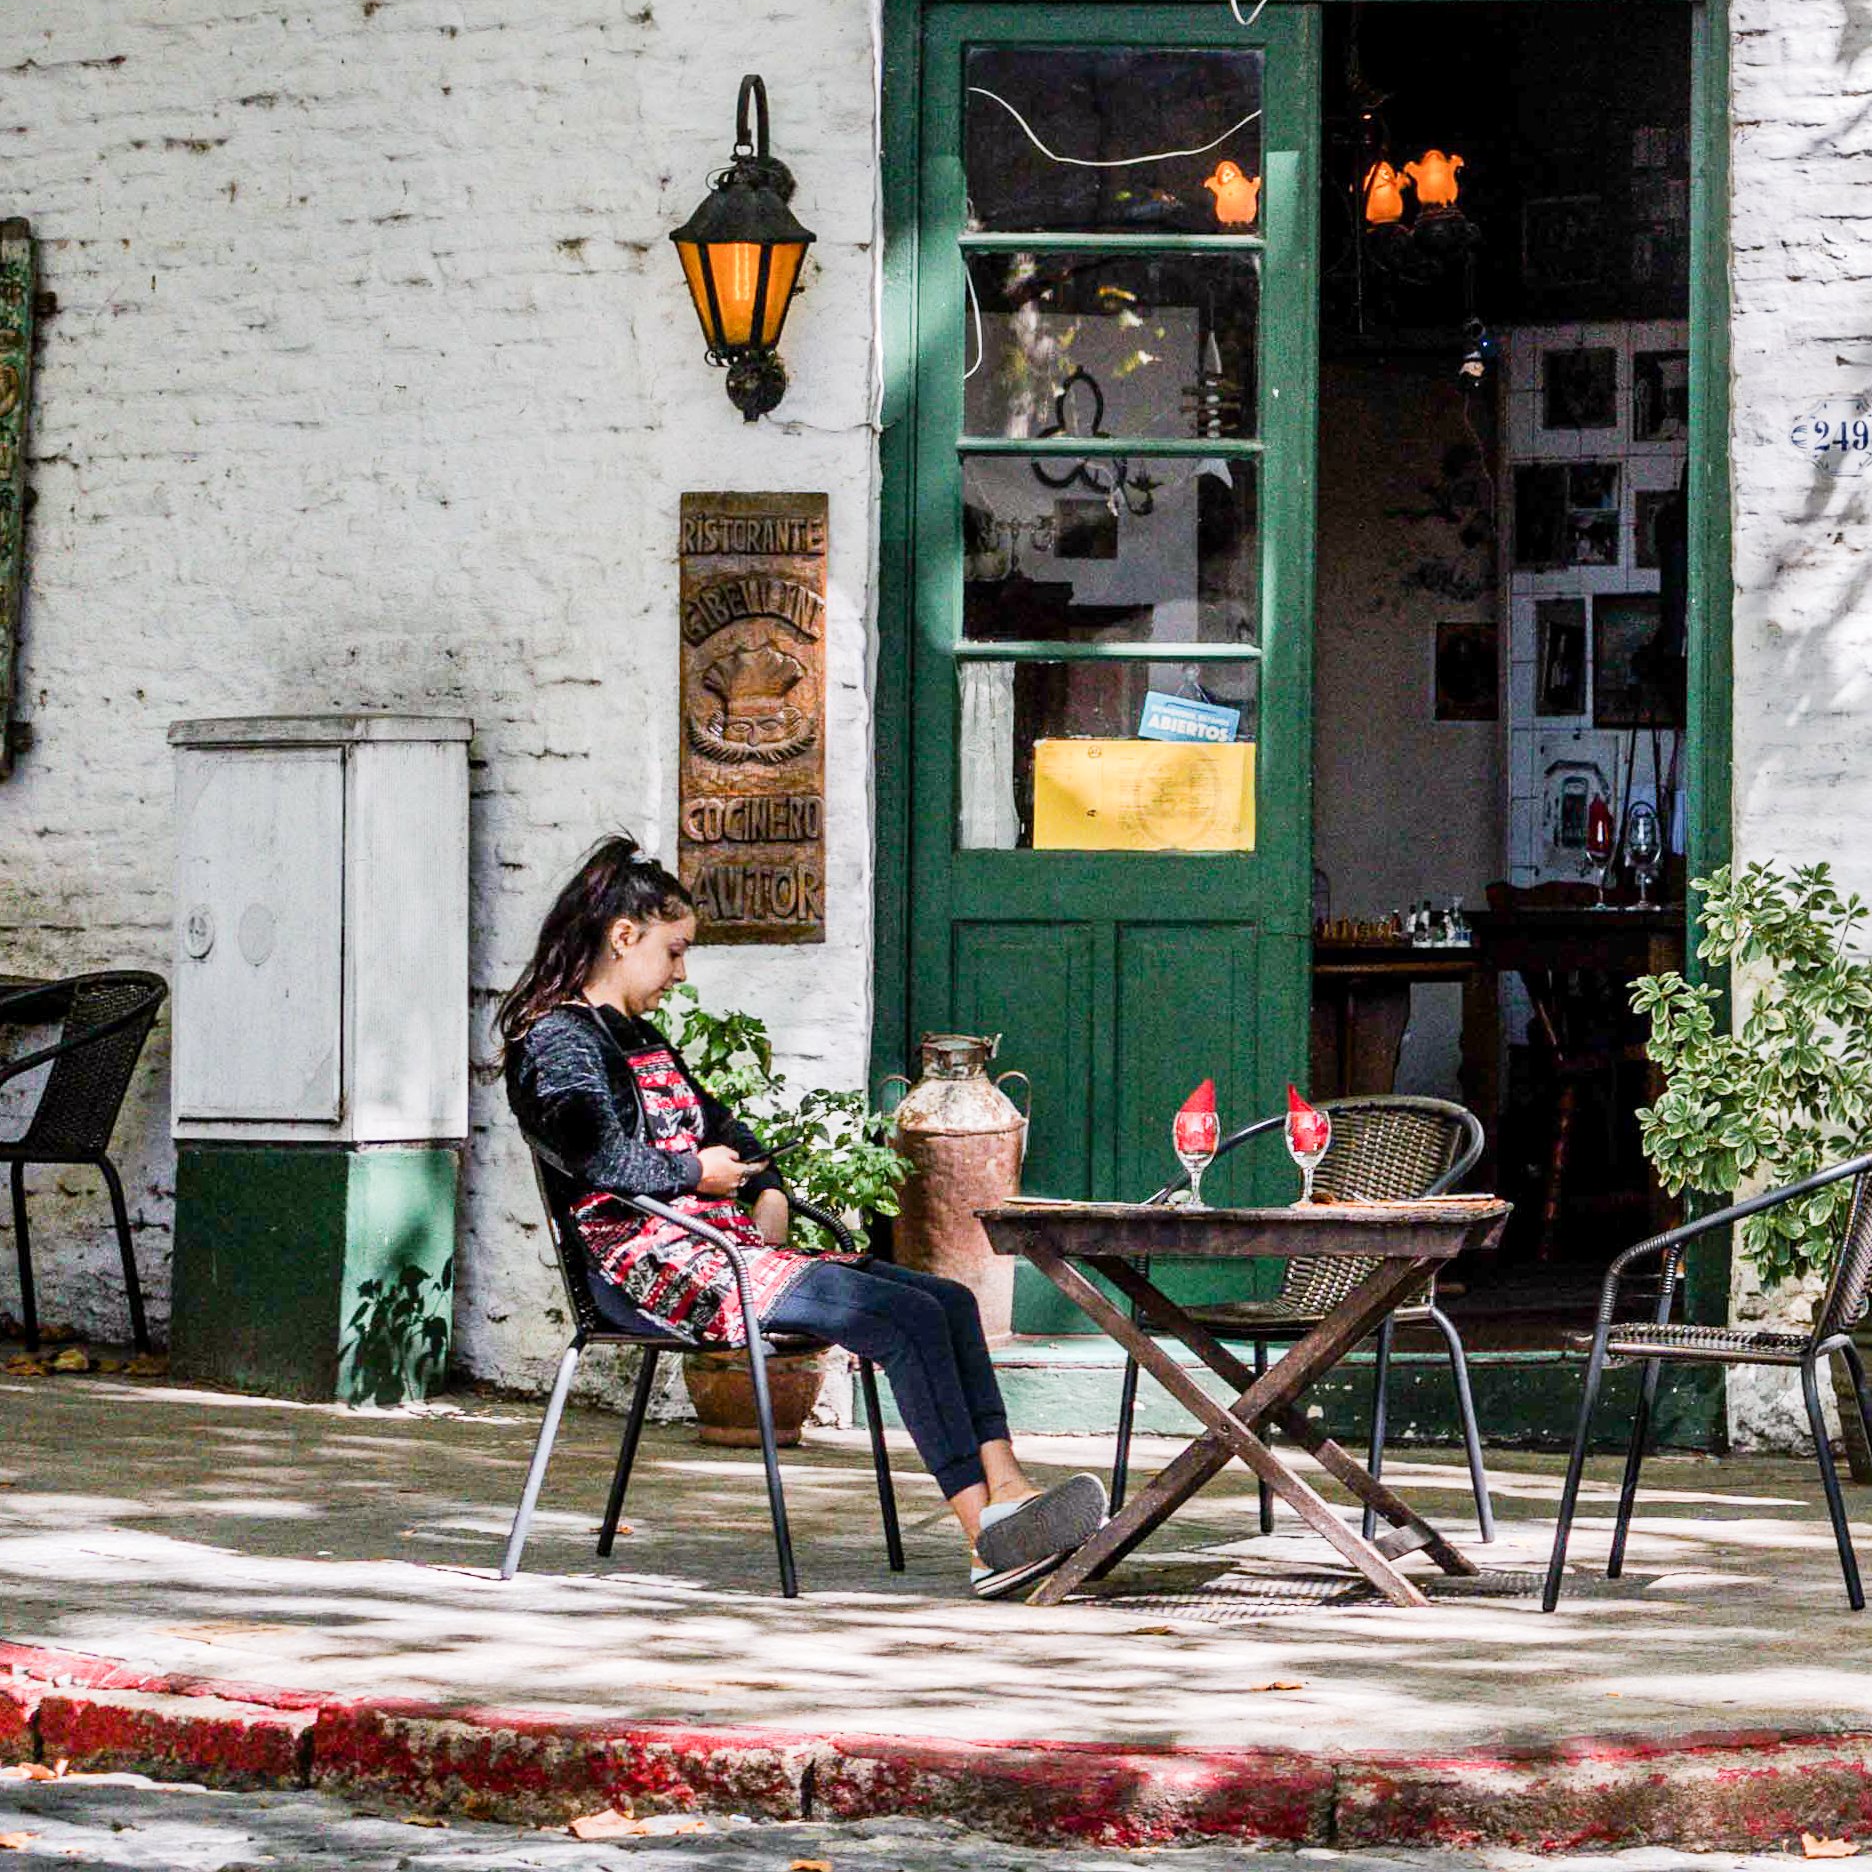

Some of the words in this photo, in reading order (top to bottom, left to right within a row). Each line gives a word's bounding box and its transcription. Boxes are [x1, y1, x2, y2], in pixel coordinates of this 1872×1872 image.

[1814, 420, 1869, 451] 249
[682, 514, 824, 553] RISTORANTE
[1147, 713, 1229, 742] ABIERTOS
[682, 797, 825, 842] COCINERO
[690, 864, 824, 921] AUTOR
